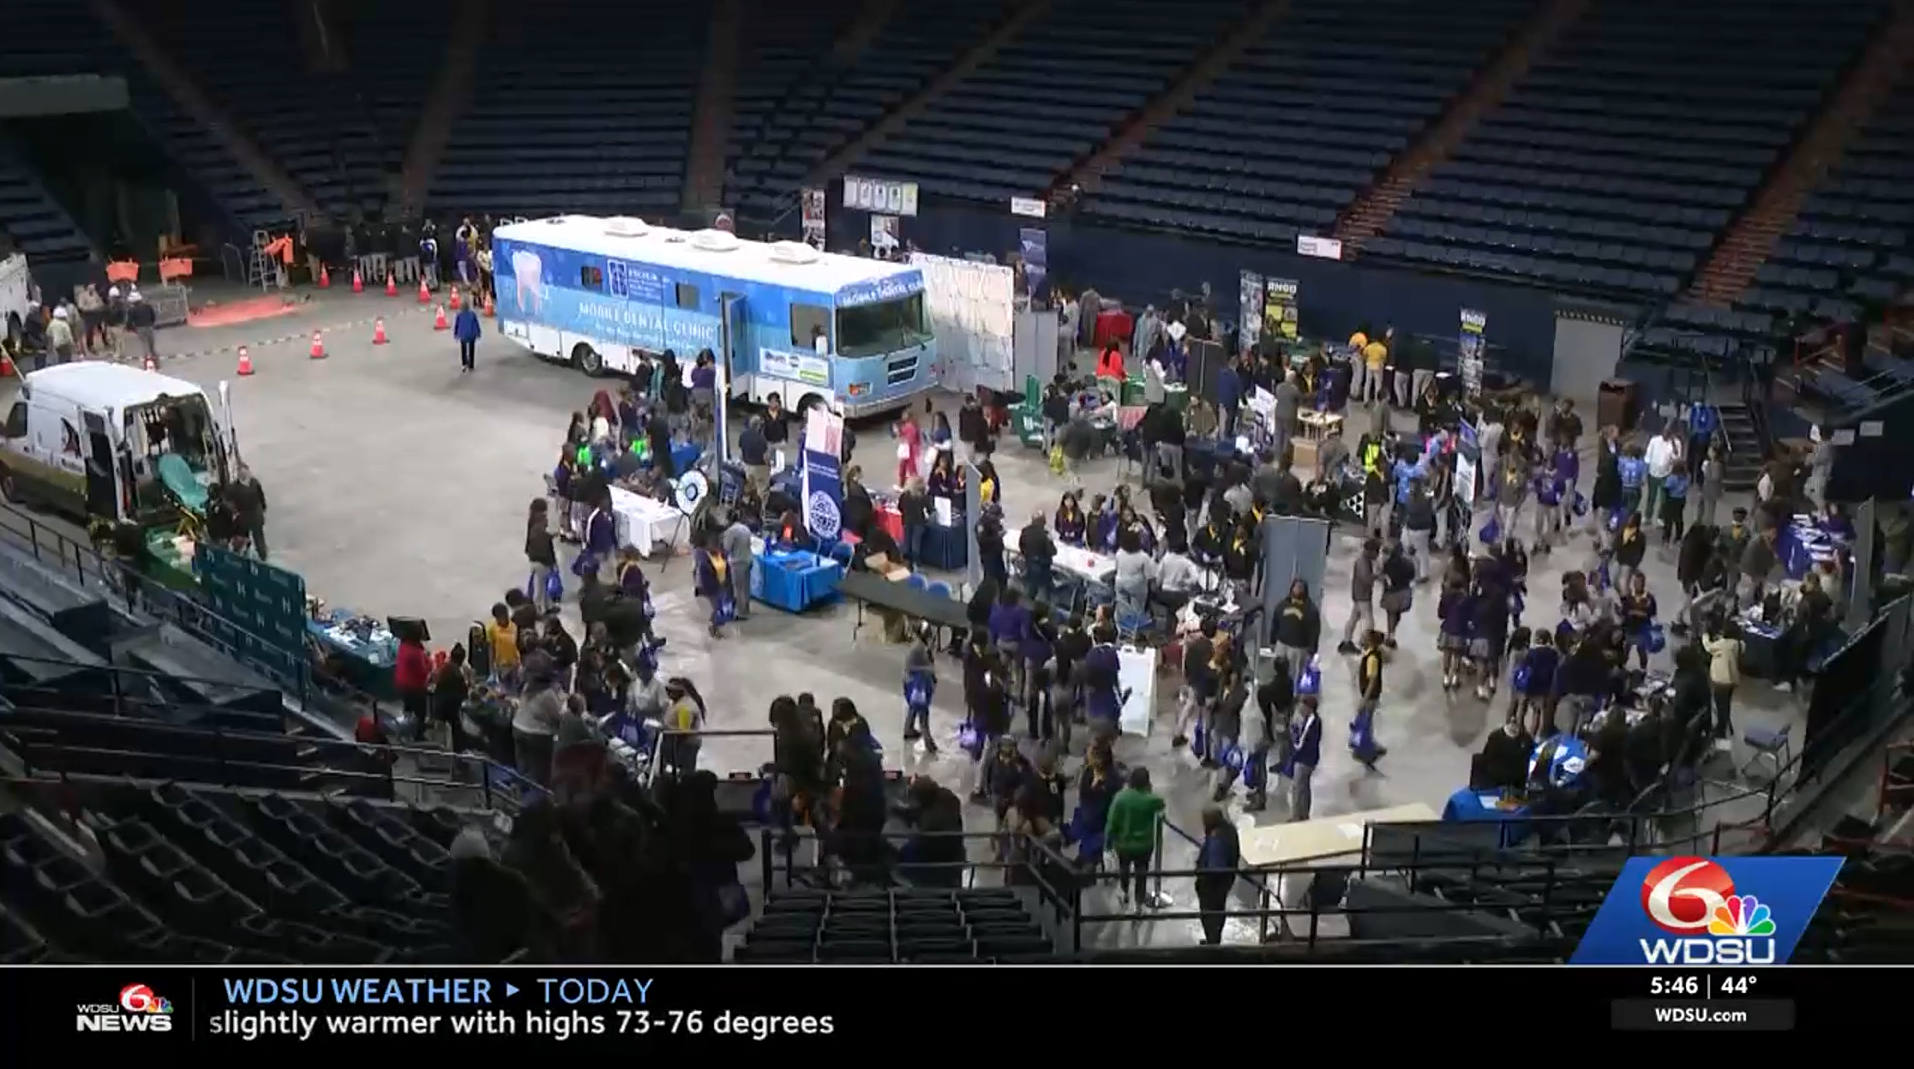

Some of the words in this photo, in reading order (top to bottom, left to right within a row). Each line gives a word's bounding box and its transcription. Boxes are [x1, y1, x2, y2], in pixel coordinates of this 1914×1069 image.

[579, 302, 619, 322] MOBILE
[624, 310, 668, 332] DENTAL
[673, 320, 716, 340] CLINIC
